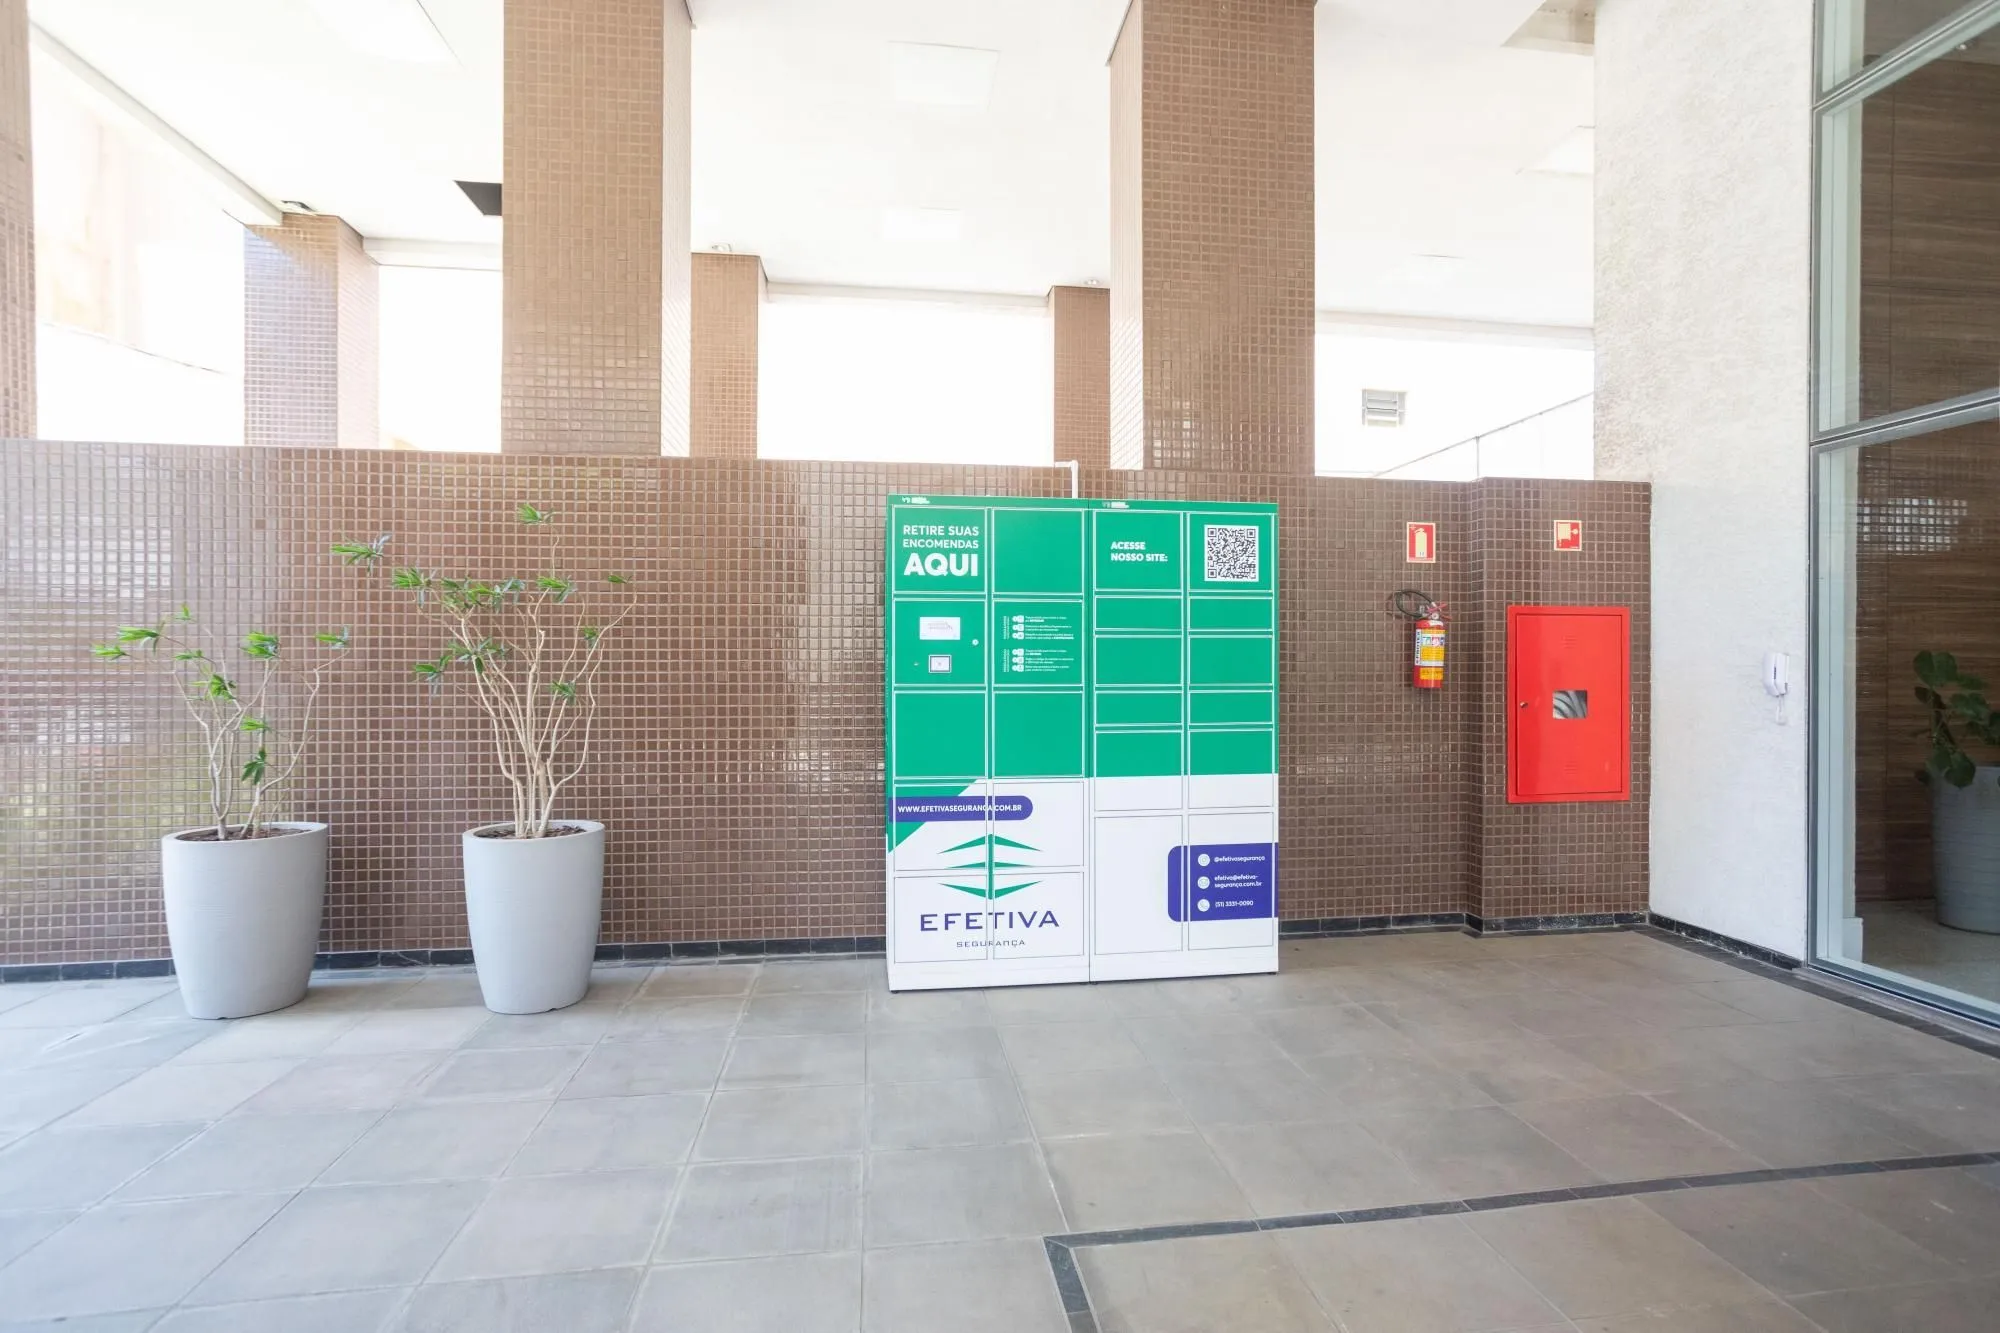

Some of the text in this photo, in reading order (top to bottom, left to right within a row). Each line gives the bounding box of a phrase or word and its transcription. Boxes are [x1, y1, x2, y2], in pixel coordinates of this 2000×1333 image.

[903, 525, 979, 536] RETIRE SUAS
[902, 538, 979, 549] ENCOMENDAS
[1110, 541, 1146, 550] ACESSE
[1110, 552, 1169, 562] NOSSO SITE:
[903, 552, 979, 577] AQUI
[897, 804, 1022, 813] WWW.EFETIVASEGURANCACOM.BR
[920, 910, 1060, 932] EFETIVA
[956, 939, 1026, 949] SEGURANÇA
